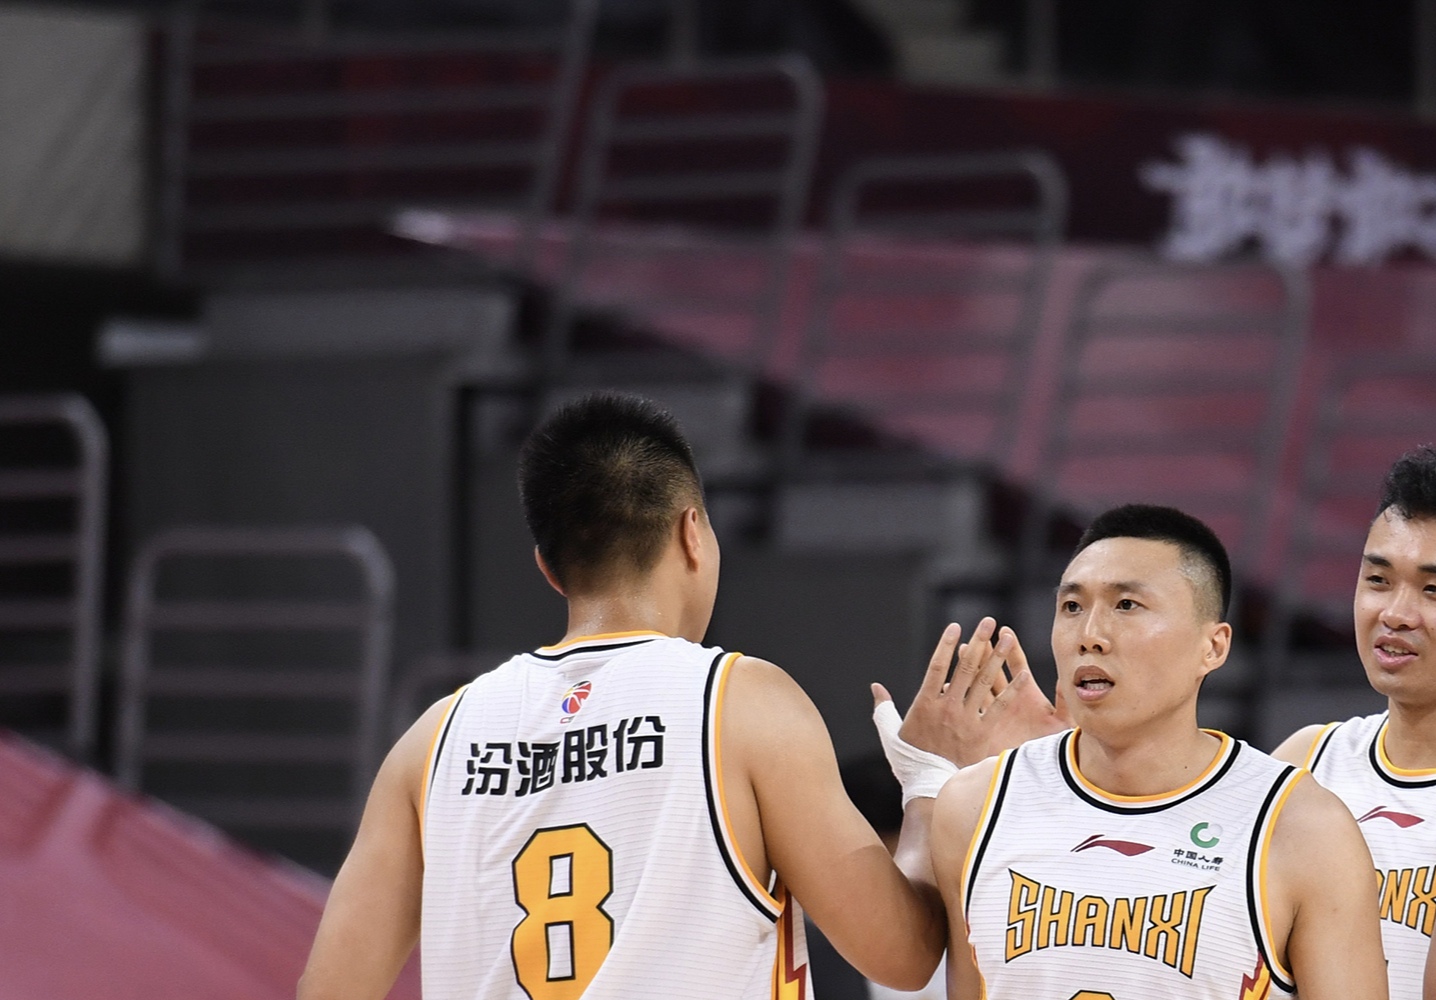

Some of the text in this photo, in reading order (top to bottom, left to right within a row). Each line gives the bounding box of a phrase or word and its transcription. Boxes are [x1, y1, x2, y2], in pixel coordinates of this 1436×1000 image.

[461, 715, 667, 798] 汾酒股份
[1170, 857, 1221, 872] CHINA LIFE
[1173, 848, 1224, 866] 中国人寿
[1005, 868, 1217, 979] SHANXI
